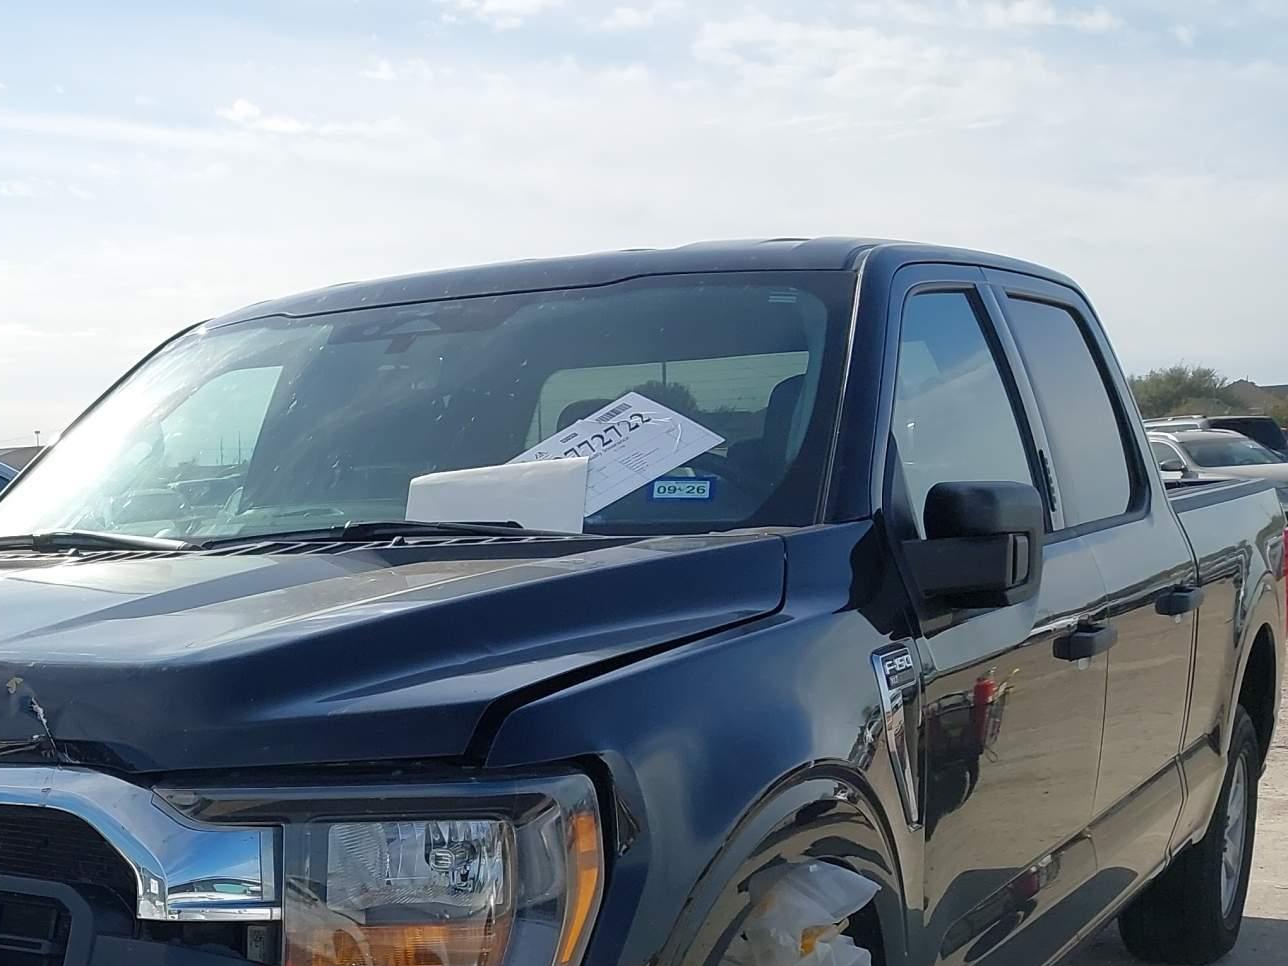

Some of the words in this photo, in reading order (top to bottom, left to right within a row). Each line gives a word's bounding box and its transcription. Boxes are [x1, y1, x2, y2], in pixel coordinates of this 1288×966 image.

[553, 413, 651, 460] 772722
[657, 485, 677, 494] 09
[685, 485, 706, 494] 26
